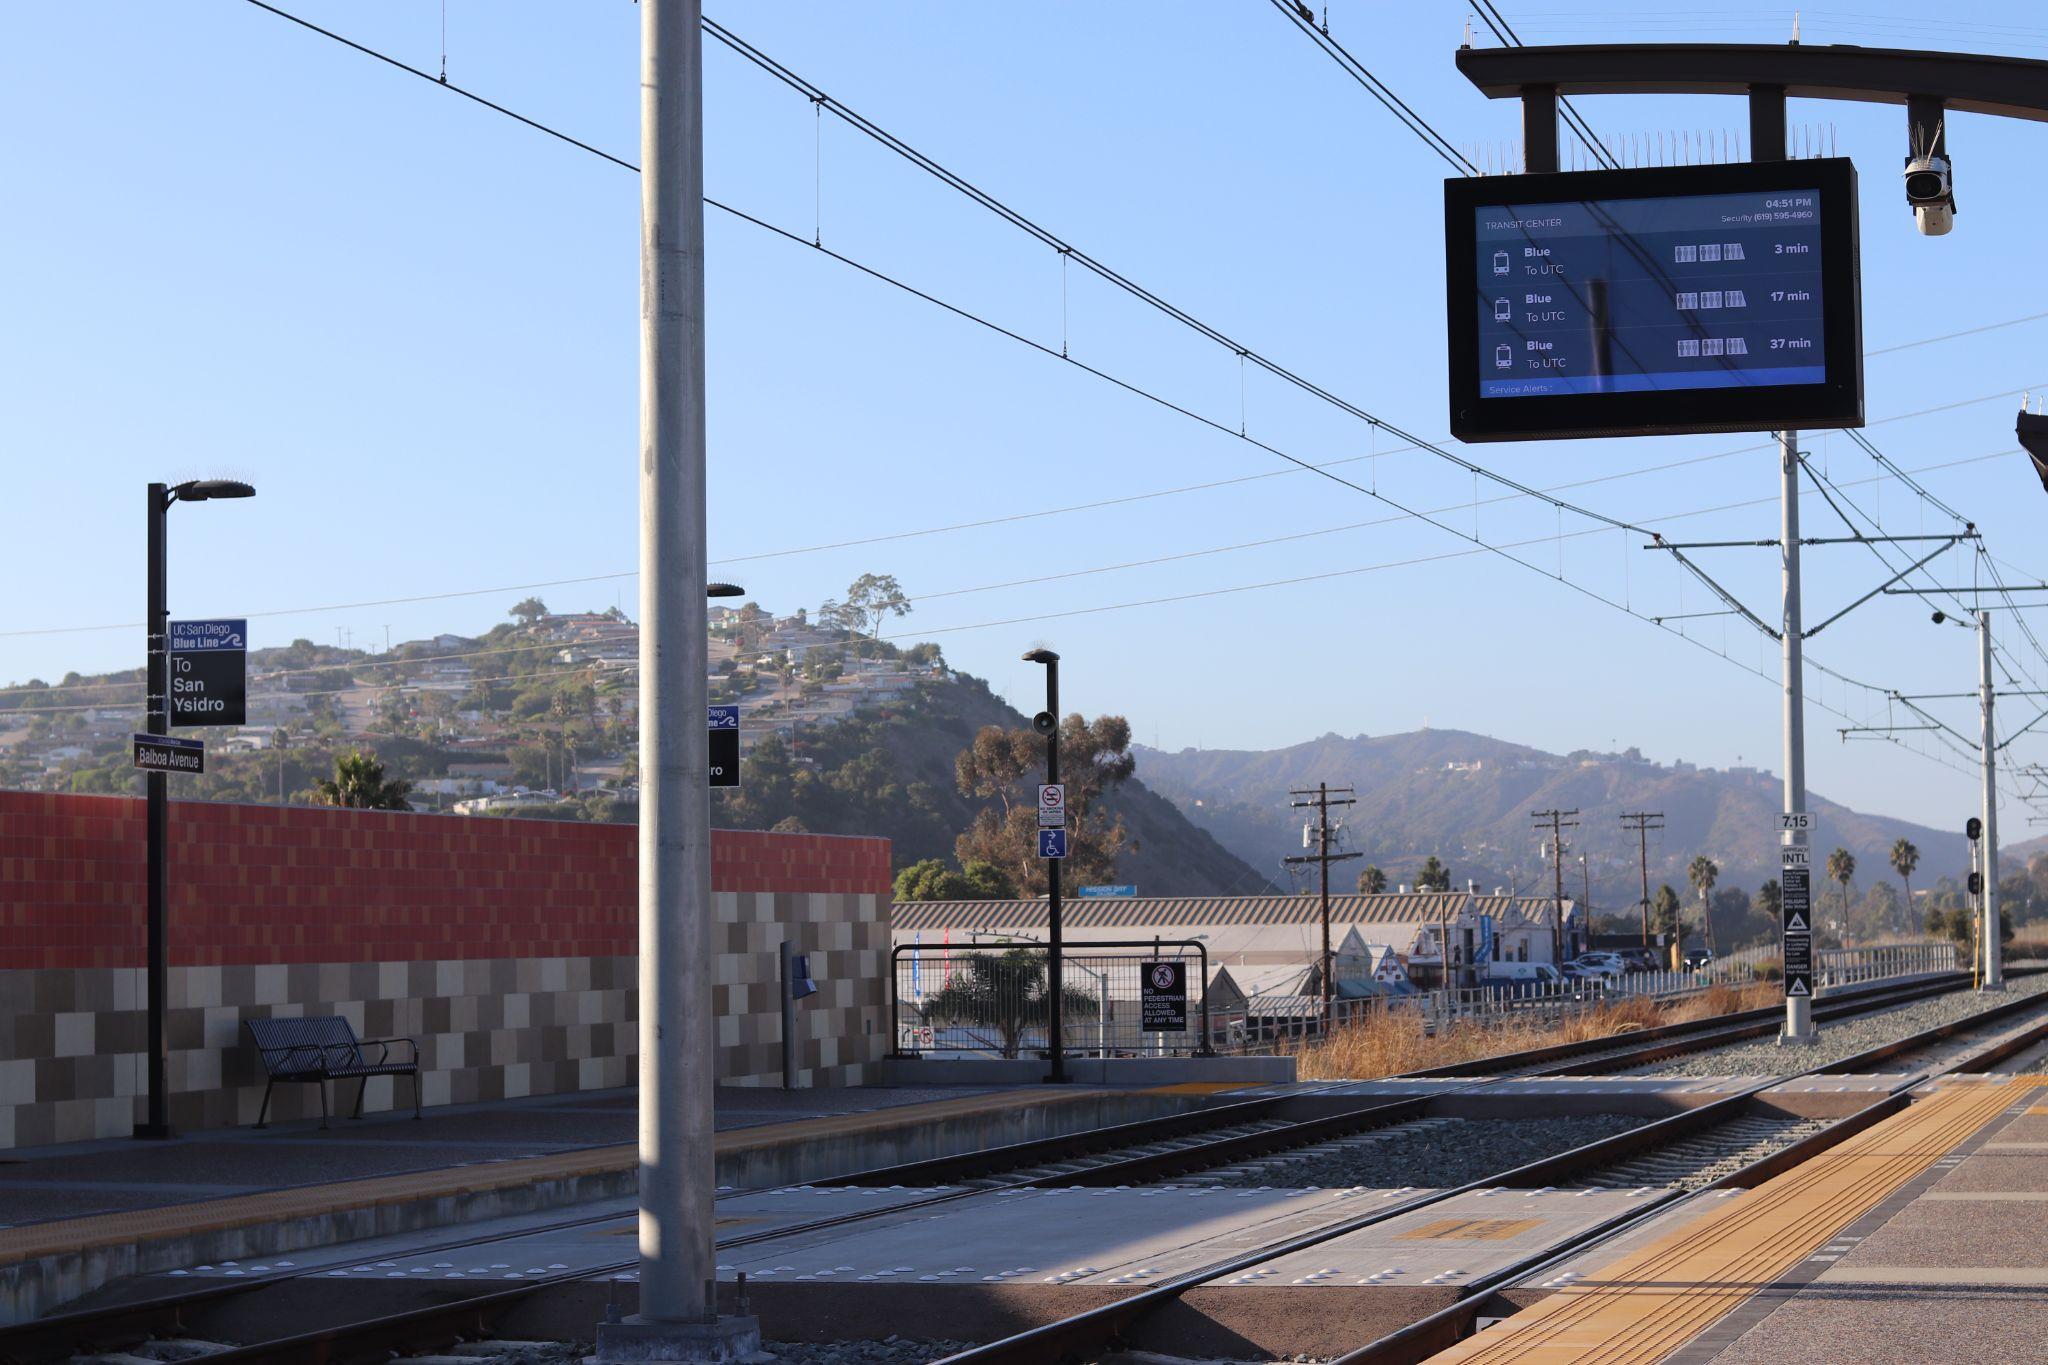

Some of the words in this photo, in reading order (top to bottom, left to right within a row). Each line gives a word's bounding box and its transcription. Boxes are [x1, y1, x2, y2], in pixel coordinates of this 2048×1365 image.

[1765, 199, 1793, 208] 04:51
[1796, 198, 1811, 207] PM
[1721, 215, 1752, 223] Security
[1754, 213, 1772, 222] (619)
[1774, 211, 1813, 219] 595-4960
[1486, 221, 1523, 230] TRANSIT
[1526, 219, 1562, 228] CENTER
[1524, 247, 1551, 257] Blue
[1775, 244, 1782, 254] 3
[1786, 243, 1808, 254] min
[1525, 266, 1538, 275] To
[1540, 265, 1564, 275] UTC
[1526, 294, 1552, 304] Blue
[1770, 291, 1784, 302] 17
[1787, 290, 1809, 301] min
[1526, 312, 1538, 322] To
[1541, 311, 1565, 321] UTC
[1527, 340, 1553, 351] Blue
[1770, 338, 1785, 349] 37
[1788, 338, 1811, 348] min
[1527, 359, 1540, 369] To
[1543, 358, 1567, 368] UTC
[1489, 386, 1520, 394] Service
[1523, 385, 1547, 393] Alerts
[173, 625, 186, 636] UC
[187, 624, 204, 635] San
[205, 623, 230, 637] Diego
[173, 637, 196, 649] Blue
[198, 636, 219, 648] Line
[173, 657, 192, 673] To
[173, 677, 204, 692] San
[174, 697, 224, 712] Ysidro
[139, 747, 167, 766] Balboa
[169, 750, 199, 768] Avenue
[1782, 815, 1808, 828] 7.15
[1782, 853, 1808, 863] INTL
